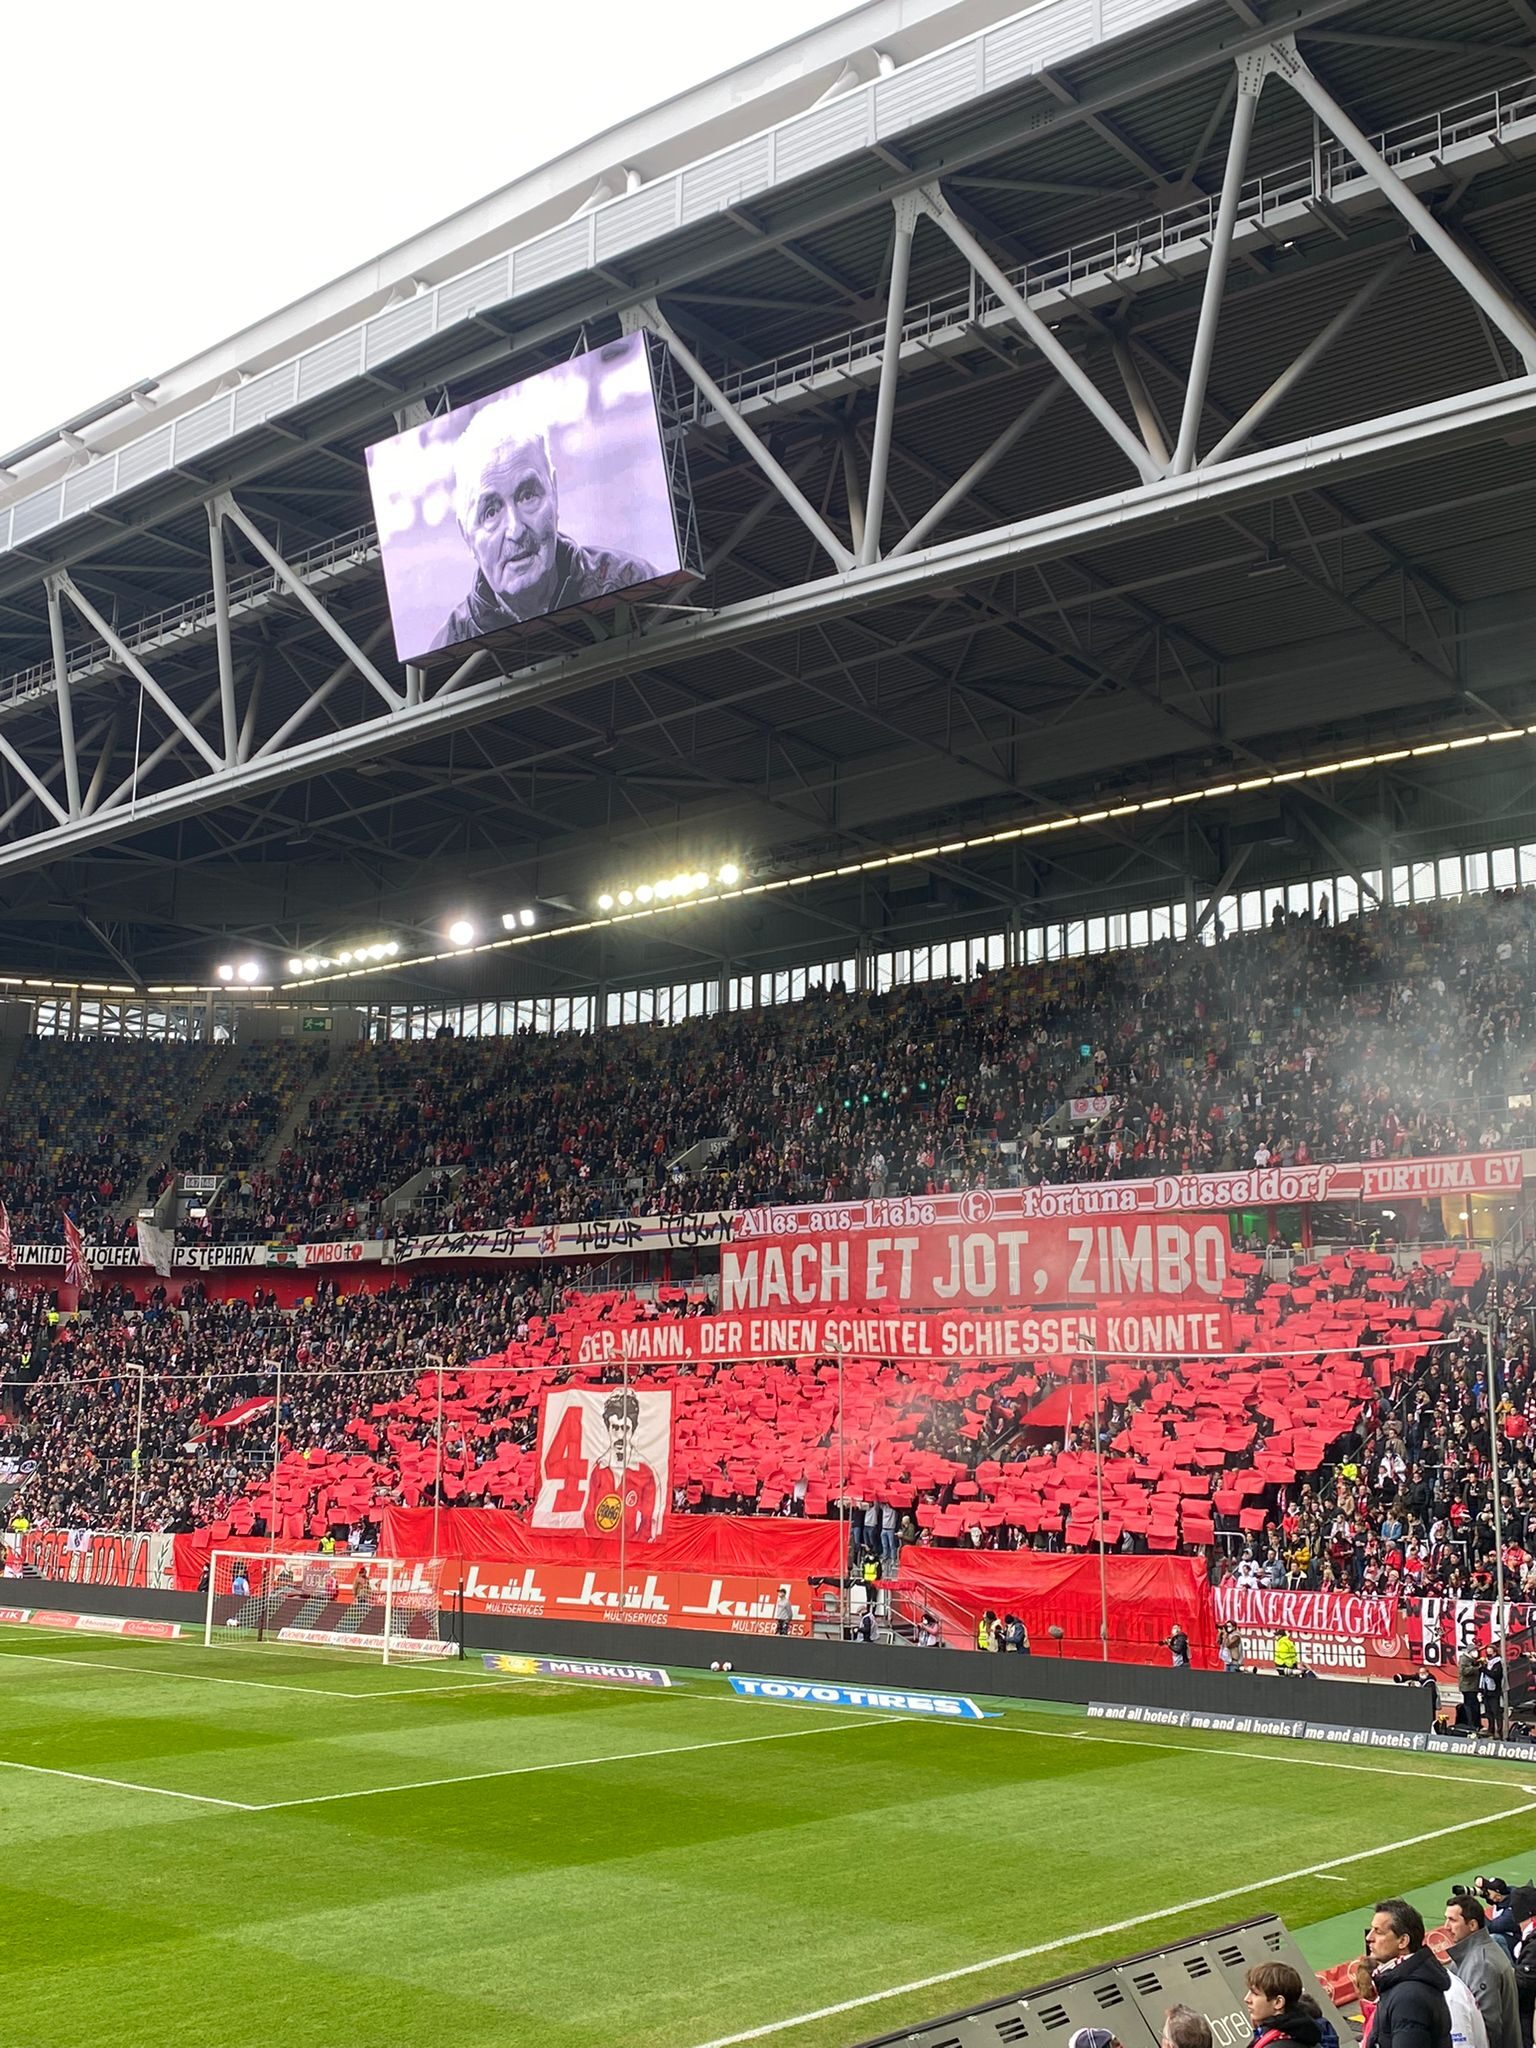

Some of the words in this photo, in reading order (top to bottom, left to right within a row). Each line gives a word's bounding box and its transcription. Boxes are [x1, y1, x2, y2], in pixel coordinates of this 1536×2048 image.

[187, 1178, 200, 1188] 147
[201, 1178, 214, 1188] 148
[1363, 1158, 1476, 1194] FORTUNA
[1485, 1156, 1521, 1186] GV
[739, 1207, 799, 1237] Alles
[809, 1208, 852, 1231] aus
[863, 1199, 937, 1229] Liebe
[1023, 1184, 1138, 1218] Fortuna
[1154, 1165, 1336, 1210] Düsseldorf
[304, 1245, 342, 1263] ZIMBO
[490, 1229, 526, 1256] OF
[722, 1240, 849, 1312] MACH
[865, 1237, 920, 1300] ET
[932, 1230, 1048, 1299] JOT,
[1067, 1224, 1226, 1296] ZIMBO
[621, 1325, 692, 1359] MANN,
[700, 1320, 743, 1355] DER
[751, 1319, 818, 1353] EINEN
[824, 1317, 932, 1354] SCHEITEL
[942, 1316, 1097, 1355] SCHIESSEN
[1107, 1313, 1223, 1353] KONNTE
[544, 1405, 588, 1513] 4
[485, 1602, 545, 1617] MULTISERVICES
[1214, 1588, 1394, 1637] MEINERZHAGEN
[549, 1662, 653, 1681] MERKUR
[737, 1680, 839, 1701] TOYO
[844, 1690, 963, 1714] TIRES
[1087, 1707, 1104, 1717] me
[1105, 1706, 1127, 1720] and
[1127, 1708, 1141, 1721] all
[1143, 1709, 1179, 1725] hotels
[1191, 1715, 1210, 1727] me
[1212, 1716, 1235, 1730] and
[1236, 1718, 1251, 1732] all
[1252, 1719, 1291, 1736] hotels
[1305, 1727, 1325, 1740] me
[1327, 1726, 1352, 1743] and
[1353, 1728, 1369, 1744] all
[1370, 1729, 1411, 1749] hotels
[1428, 1738, 1448, 1752] me
[1450, 1739, 1476, 1757] and
[1478, 1741, 1495, 1758] all
